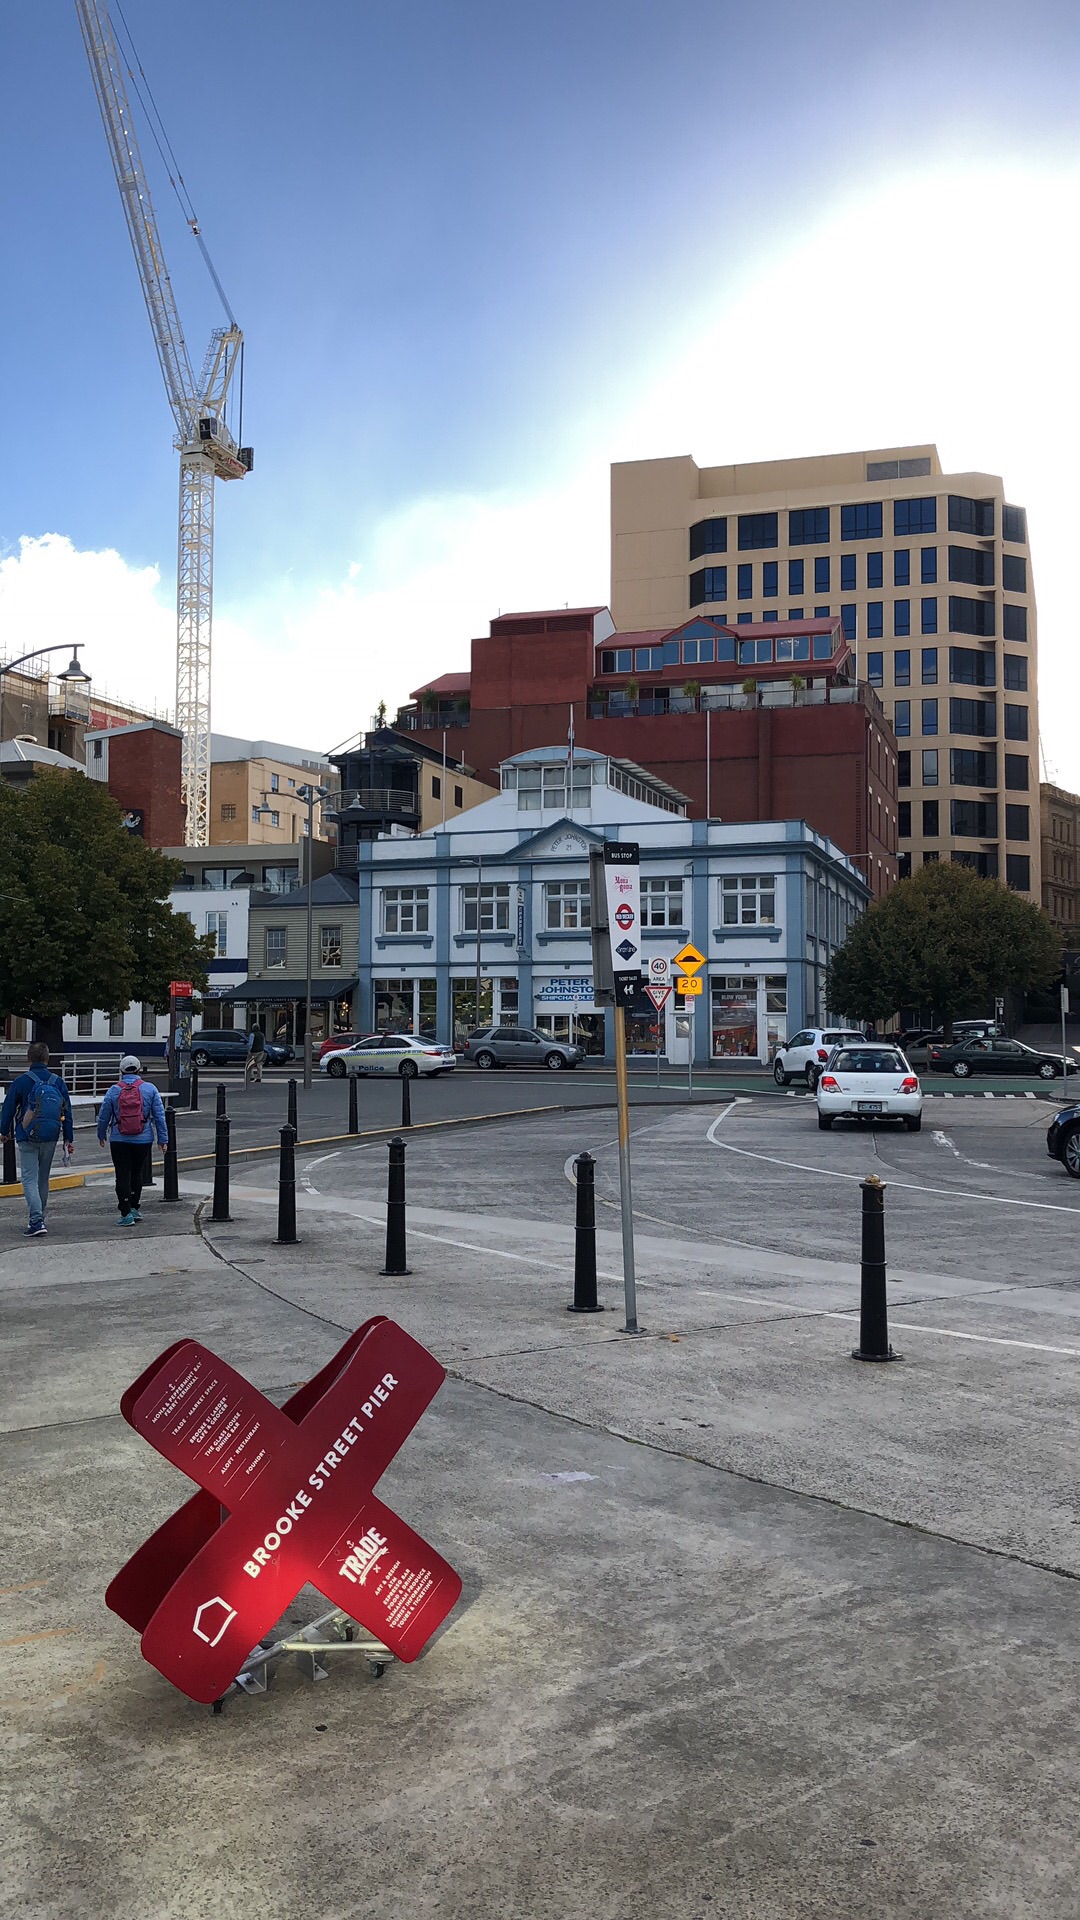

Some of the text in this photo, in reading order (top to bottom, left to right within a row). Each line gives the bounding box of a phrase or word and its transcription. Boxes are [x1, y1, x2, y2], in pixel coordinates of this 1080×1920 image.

[551, 833, 587, 852] PETER JOHNSTON
[654, 962, 664, 970] 40
[682, 979, 697, 988] 20
[151, 1406, 167, 1423] MONA
[168, 1371, 195, 1402] PEPPERMINT
[193, 1361, 203, 1372] BAY
[164, 1375, 199, 1417] FERRY TERMINAL
[171, 1418, 187, 1436] TRADE
[188, 1394, 206, 1416] MARKET
[204, 1379, 218, 1395] SPACE
[189, 1422, 207, 1444] BROOKE
[210, 1397, 227, 1417] LARDER
[196, 1429, 208, 1443] CAFE
[210, 1403, 228, 1425] GROCER
[204, 1445, 215, 1457] THE
[213, 1430, 227, 1446] GLASS
[225, 1412, 241, 1430] HOUSE
[215, 1421, 240, 1452] DINING BAR
[220, 1457, 235, 1475] ALOFT
[235, 1422, 261, 1454] RESTAURANT
[245, 1448, 267, 1475] FOUNDRY
[242, 1371, 399, 1579] BROOKE STREET PIER
[338, 1527, 387, 1583] TRADE
[374, 1584, 384, 1596] ART
[385, 1560, 401, 1580] DESIGN
[382, 1568, 411, 1605] ESPRESSO BAR
[386, 1568, 426, 1623] TASMANIAN PRODUCE
[387, 1576, 397, 1589] ATM
[387, 1594, 400, 1610] FOOD
[401, 1572, 415, 1590] DRINK
[389, 1570, 432, 1629] TOURIST INFORMATION
[397, 1610, 411, 1628] TOURS
[413, 1579, 433, 1606] TICKETING
